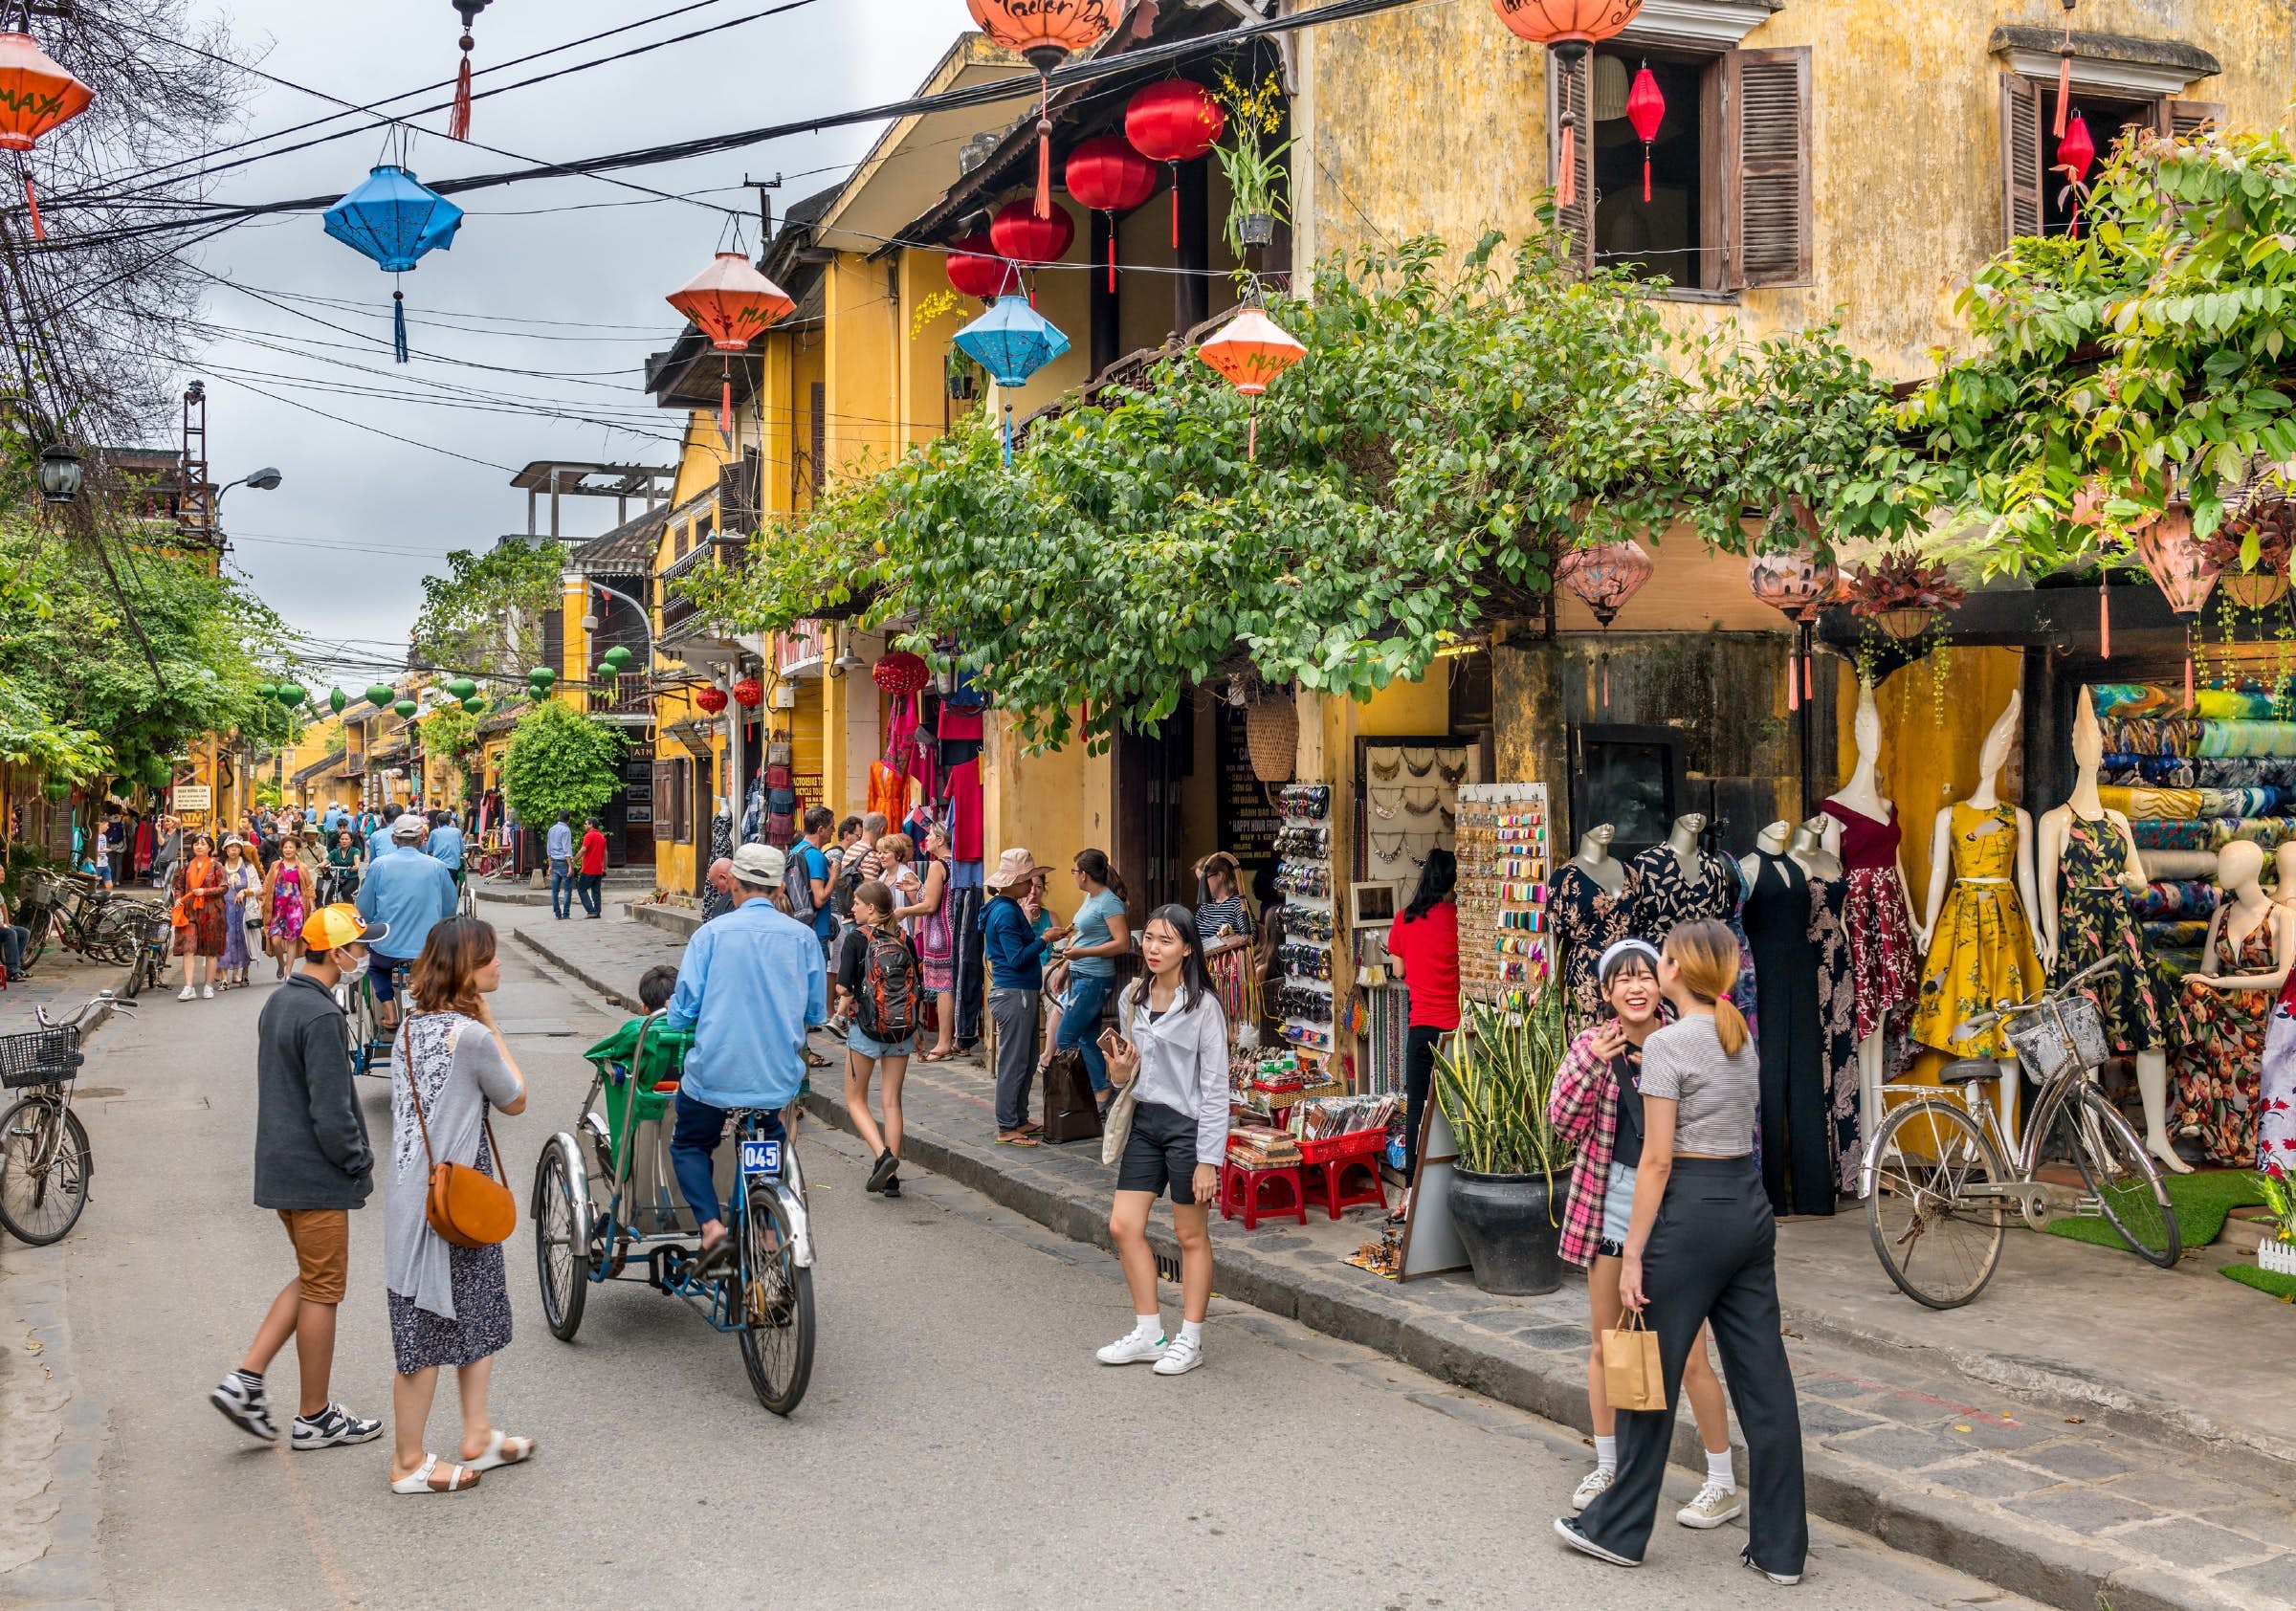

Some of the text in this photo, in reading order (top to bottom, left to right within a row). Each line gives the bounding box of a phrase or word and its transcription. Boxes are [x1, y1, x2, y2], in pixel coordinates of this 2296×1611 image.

[633, 748, 652, 757] ATM
[1232, 819, 1250, 832] HAPPY
[745, 1146, 777, 1167] 045
